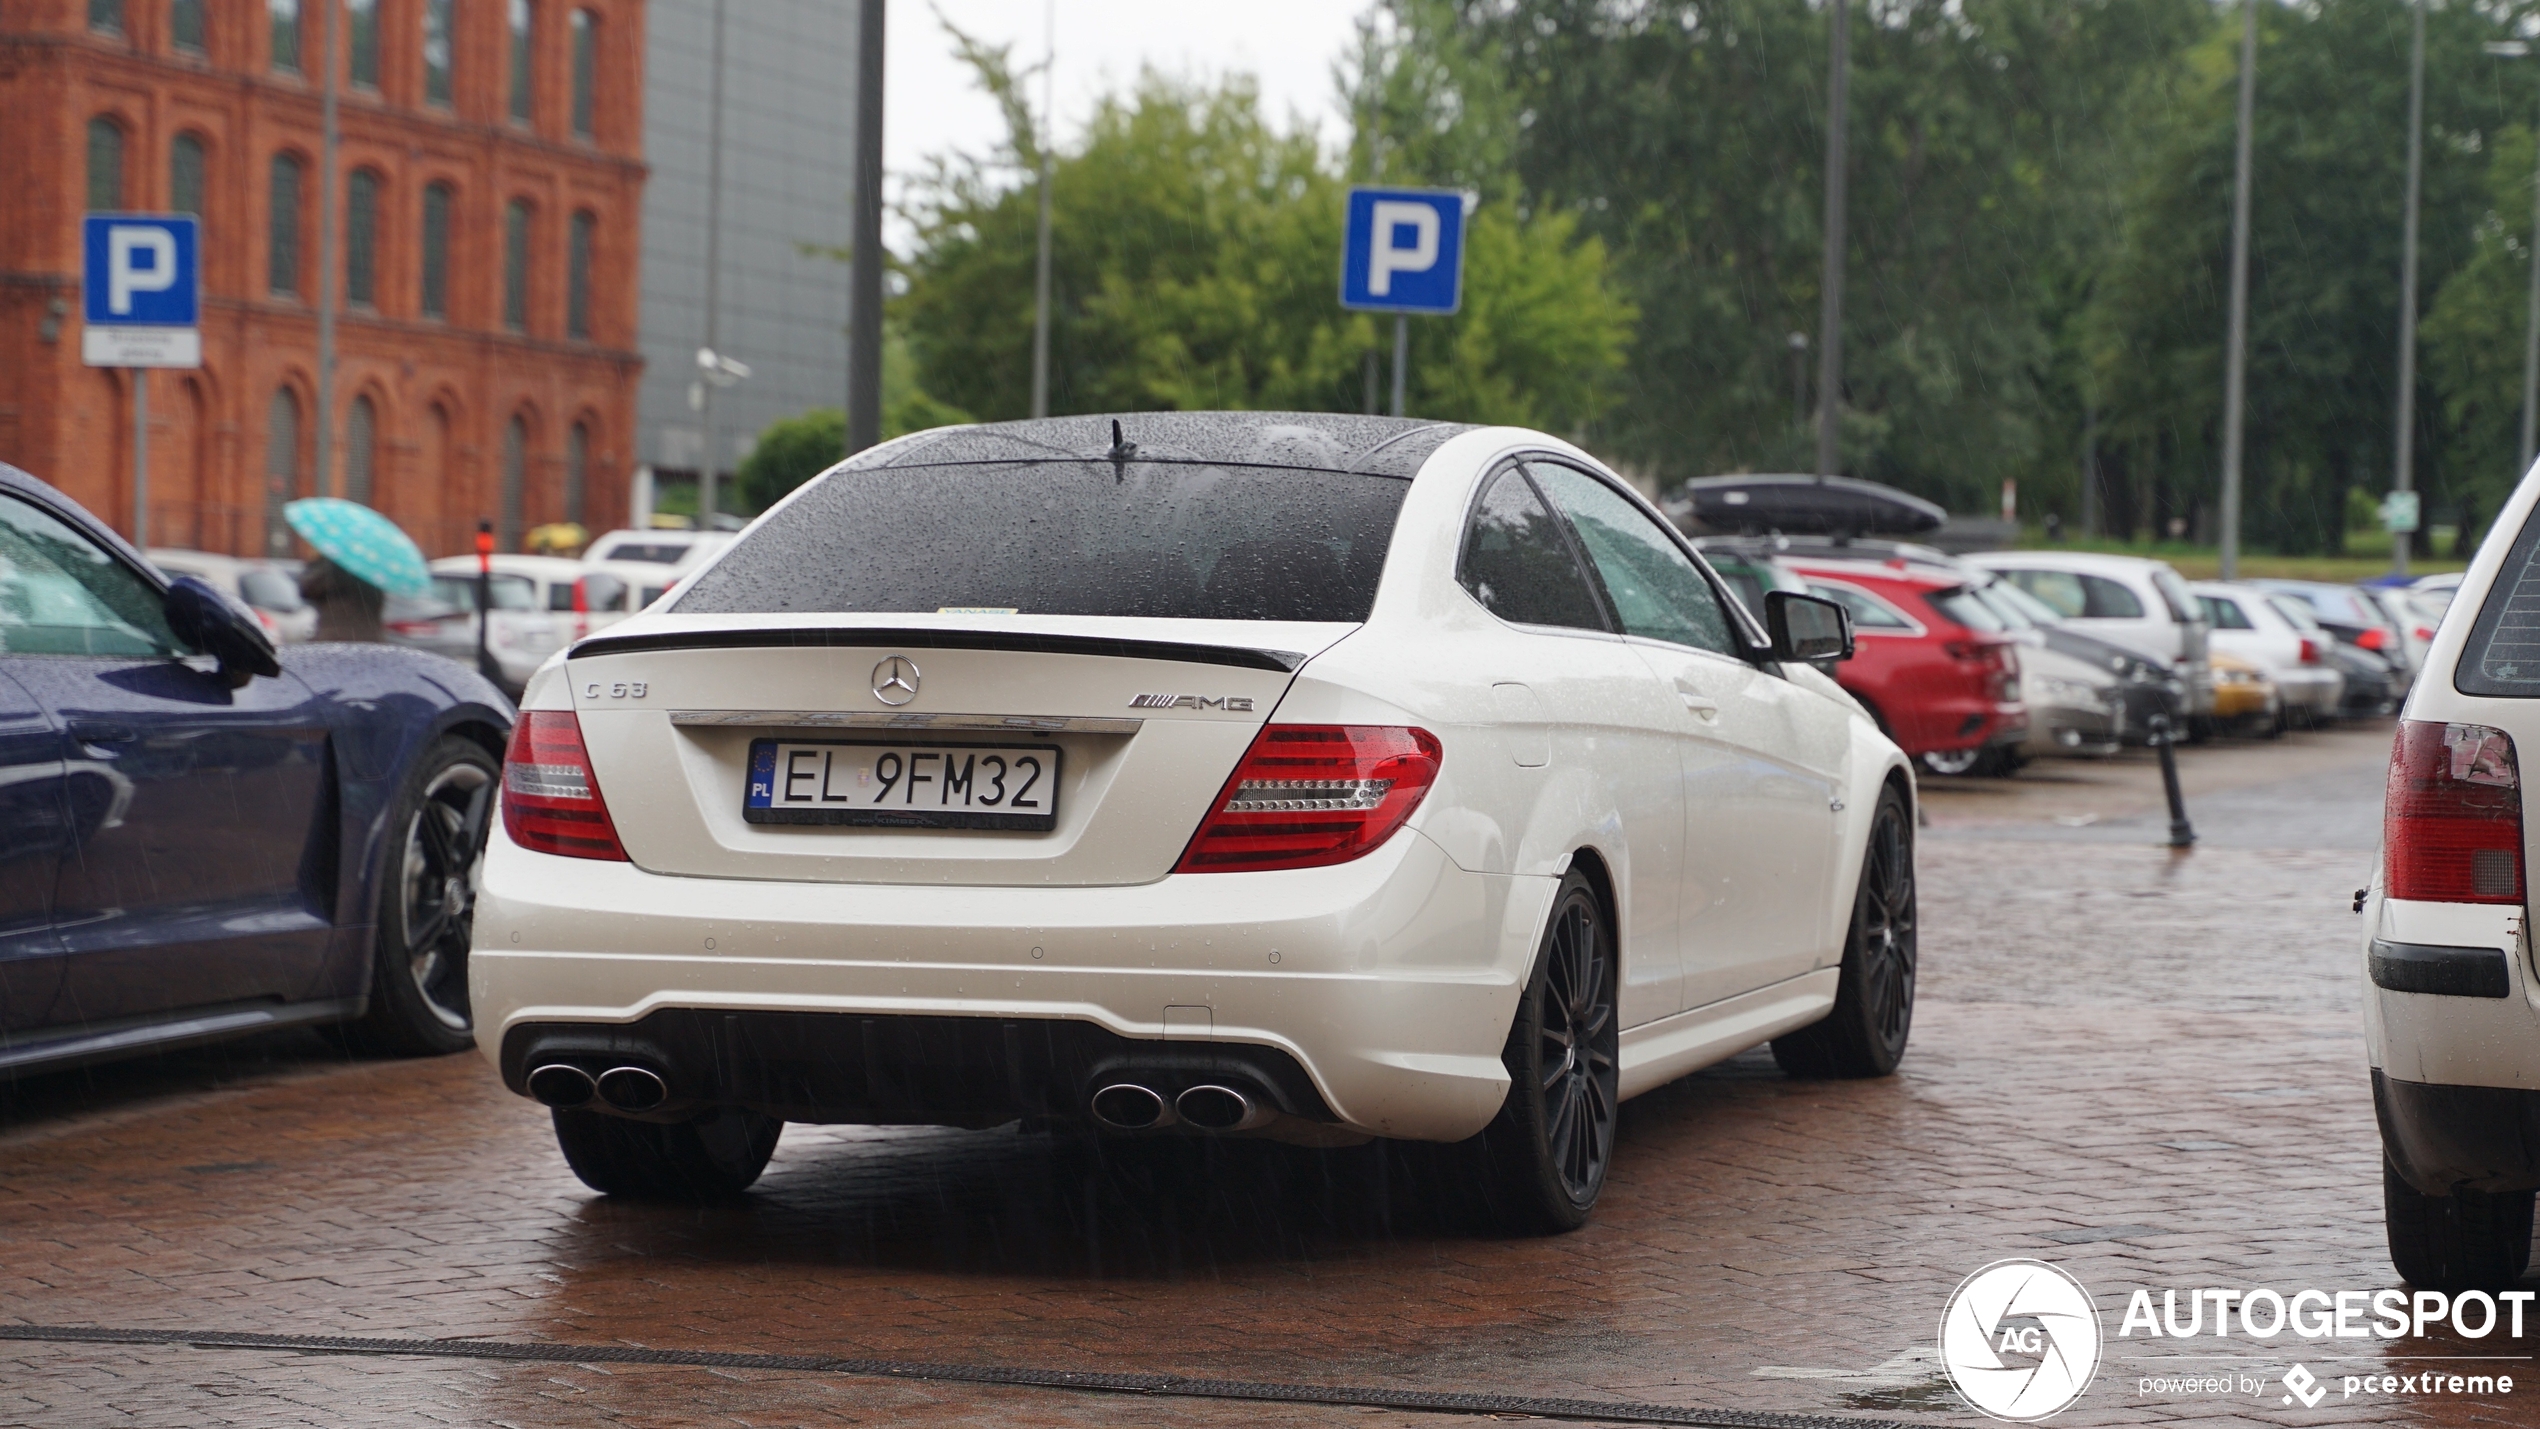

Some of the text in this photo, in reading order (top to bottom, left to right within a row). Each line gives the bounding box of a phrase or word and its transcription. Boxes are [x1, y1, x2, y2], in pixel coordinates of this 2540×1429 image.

[1368, 200, 1440, 296] P
[108, 225, 177, 315] P
[585, 681, 647, 699] C 63
[1168, 694, 1254, 712] AMG
[752, 783, 770, 798] PL
[784, 751, 1041, 807] EL 9FM32
